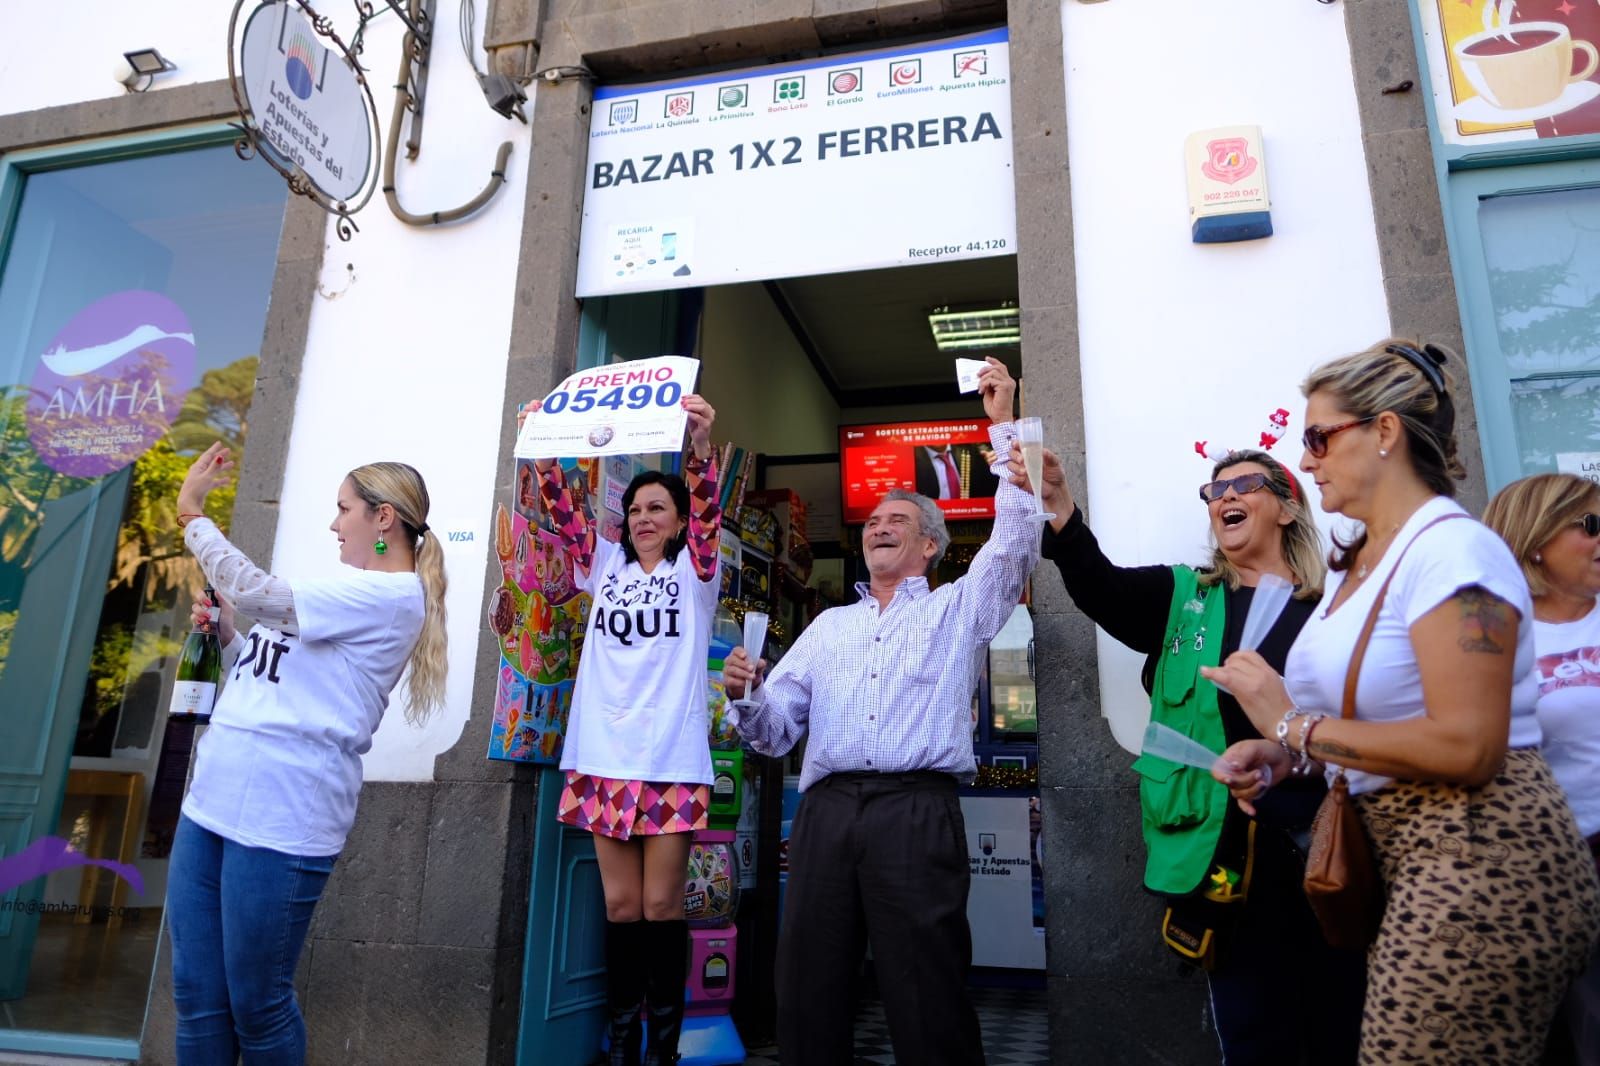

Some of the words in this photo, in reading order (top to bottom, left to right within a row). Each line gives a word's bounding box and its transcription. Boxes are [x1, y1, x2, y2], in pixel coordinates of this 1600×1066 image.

[876, 85, 934, 99] EuroMillones
[939, 83, 976, 92] Apuesta
[826, 99, 834, 107] El
[837, 95, 863, 105] Gordo
[719, 111, 755, 121] Primitiva
[620, 123, 653, 133] Nacional
[656, 121, 665, 129] La
[667, 117, 699, 128] Quiniela
[262, 119, 306, 168] Estado
[266, 101, 323, 164] Apuestas
[325, 157, 343, 181] del
[321, 132, 329, 148] y
[592, 147, 714, 189] BAZAR
[729, 136, 802, 171] 1X2
[817, 112, 1002, 160] FERRERA
[617, 226, 653, 236] RECARGA
[908, 245, 961, 258] Receptor
[966, 239, 1006, 251] 44.120
[577, 367, 673, 388] PREMIO
[40, 379, 165, 421] AMHA
[542, 382, 682, 415] 05490
[111, 426, 131, 434] POR
[133, 424, 144, 433] LA
[908, 425, 978, 434] EXTRAORDINARIO
[915, 433, 951, 441] NAVIDAD
[68, 448, 81, 456] DE
[448, 531, 474, 541] VISA
[594, 598, 681, 646] AQUÍ
[1019, 700, 1035, 713] 17
[990, 857, 1031, 866] Apuestas
[981, 867, 1011, 875] Estado
